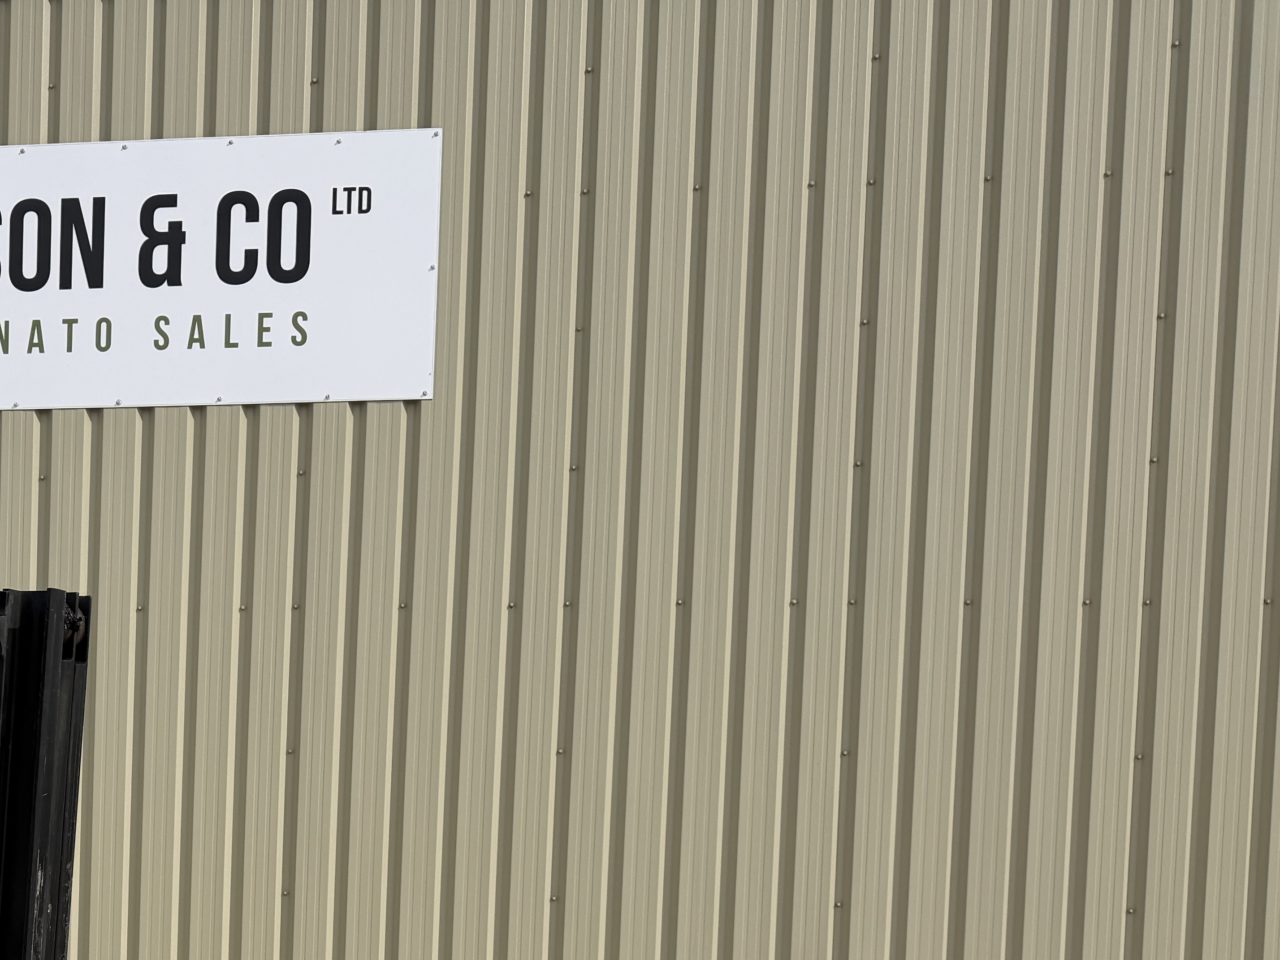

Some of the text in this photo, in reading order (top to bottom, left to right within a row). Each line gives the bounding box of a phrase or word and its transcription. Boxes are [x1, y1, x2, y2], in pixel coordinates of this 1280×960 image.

[137, 193, 187, 289] &
[215, 188, 312, 286] CO
[331, 186, 372, 216] LTD
[153, 311, 309, 351] SALES
